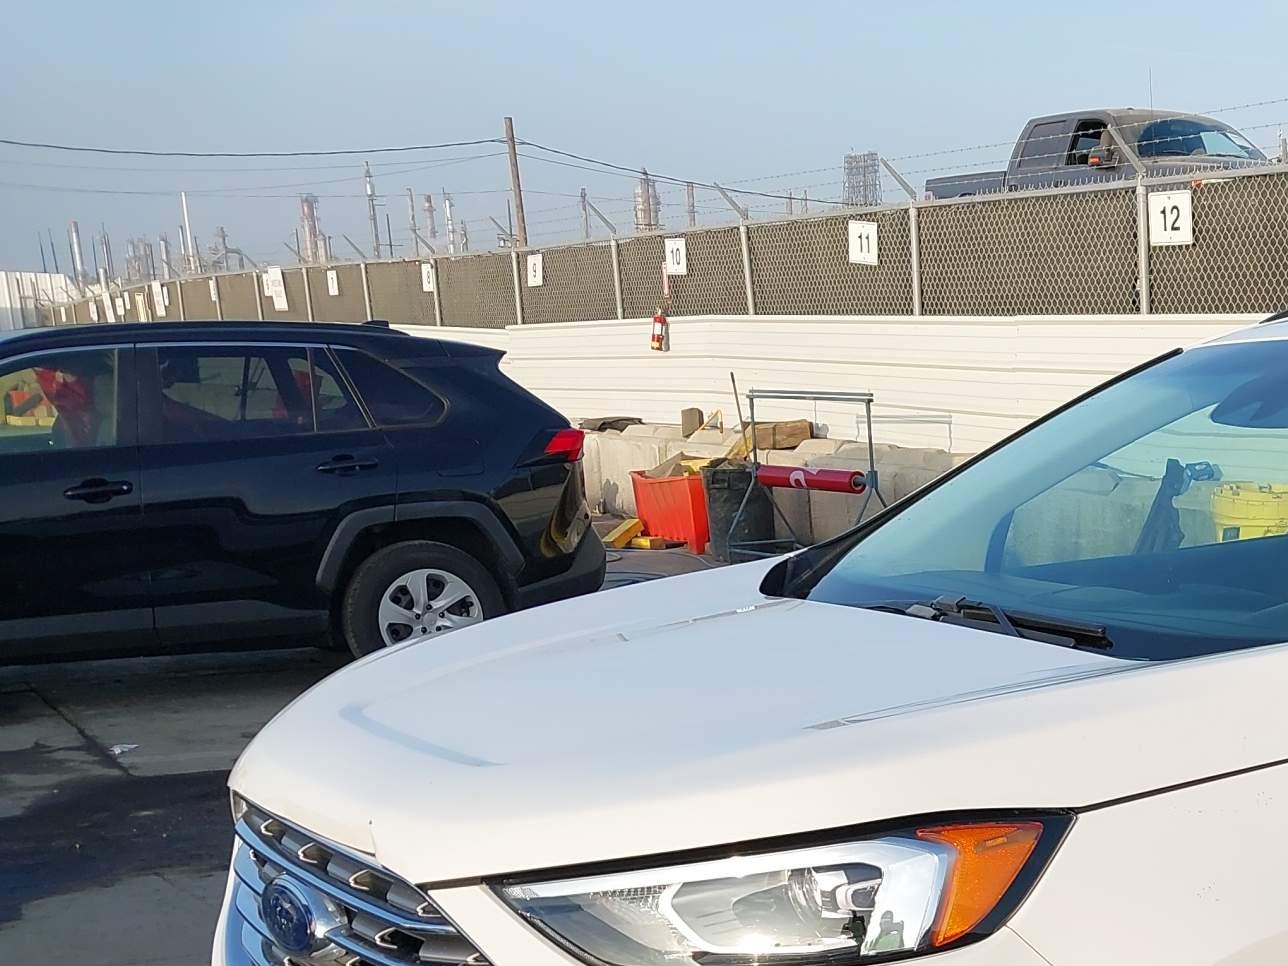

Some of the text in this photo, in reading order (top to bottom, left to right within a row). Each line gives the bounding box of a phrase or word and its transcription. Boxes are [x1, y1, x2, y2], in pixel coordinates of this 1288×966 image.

[1160, 205, 1180, 231] 12
[857, 231, 870, 254] 11
[670, 247, 681, 266] 10
[532, 263, 537, 278] 9
